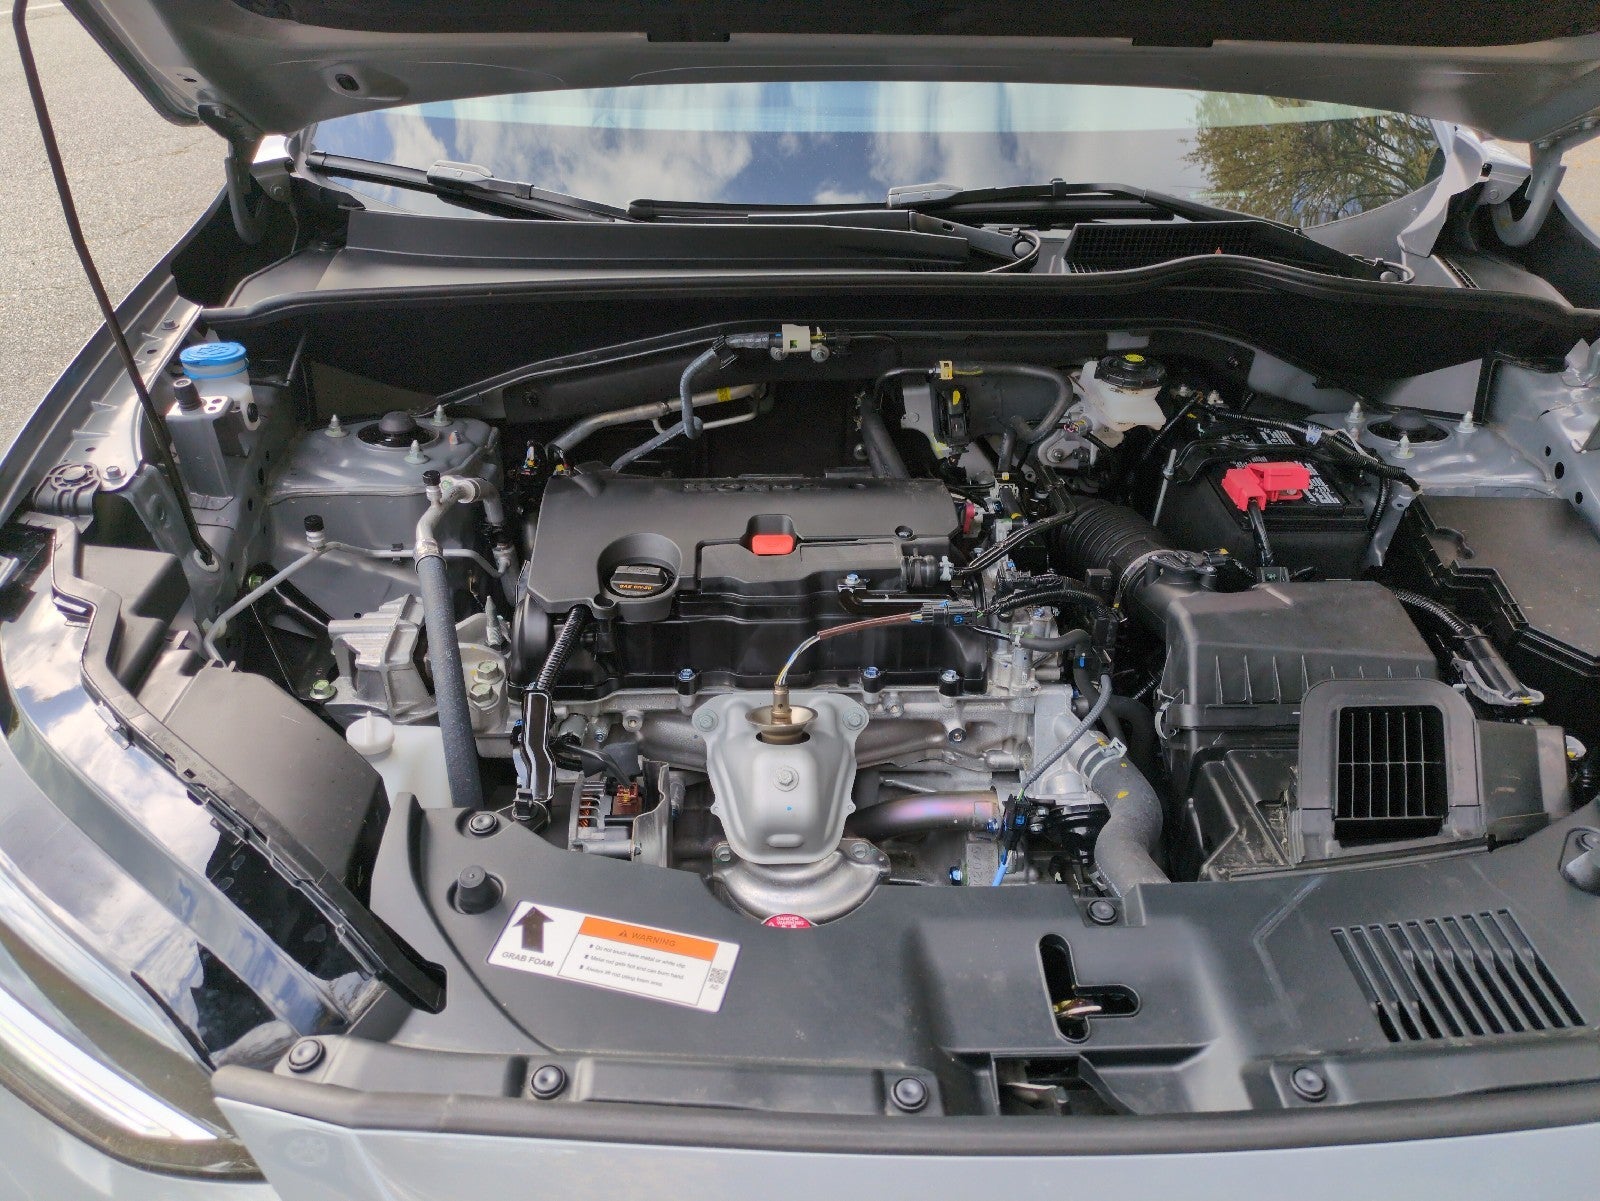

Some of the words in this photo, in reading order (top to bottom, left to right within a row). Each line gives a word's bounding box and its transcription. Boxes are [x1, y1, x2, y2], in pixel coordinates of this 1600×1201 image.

[631, 932, 677, 947] WARNING
[502, 951, 527, 962] GRAB
[528, 956, 555, 967] FOAM
[621, 974, 636, 982] using
